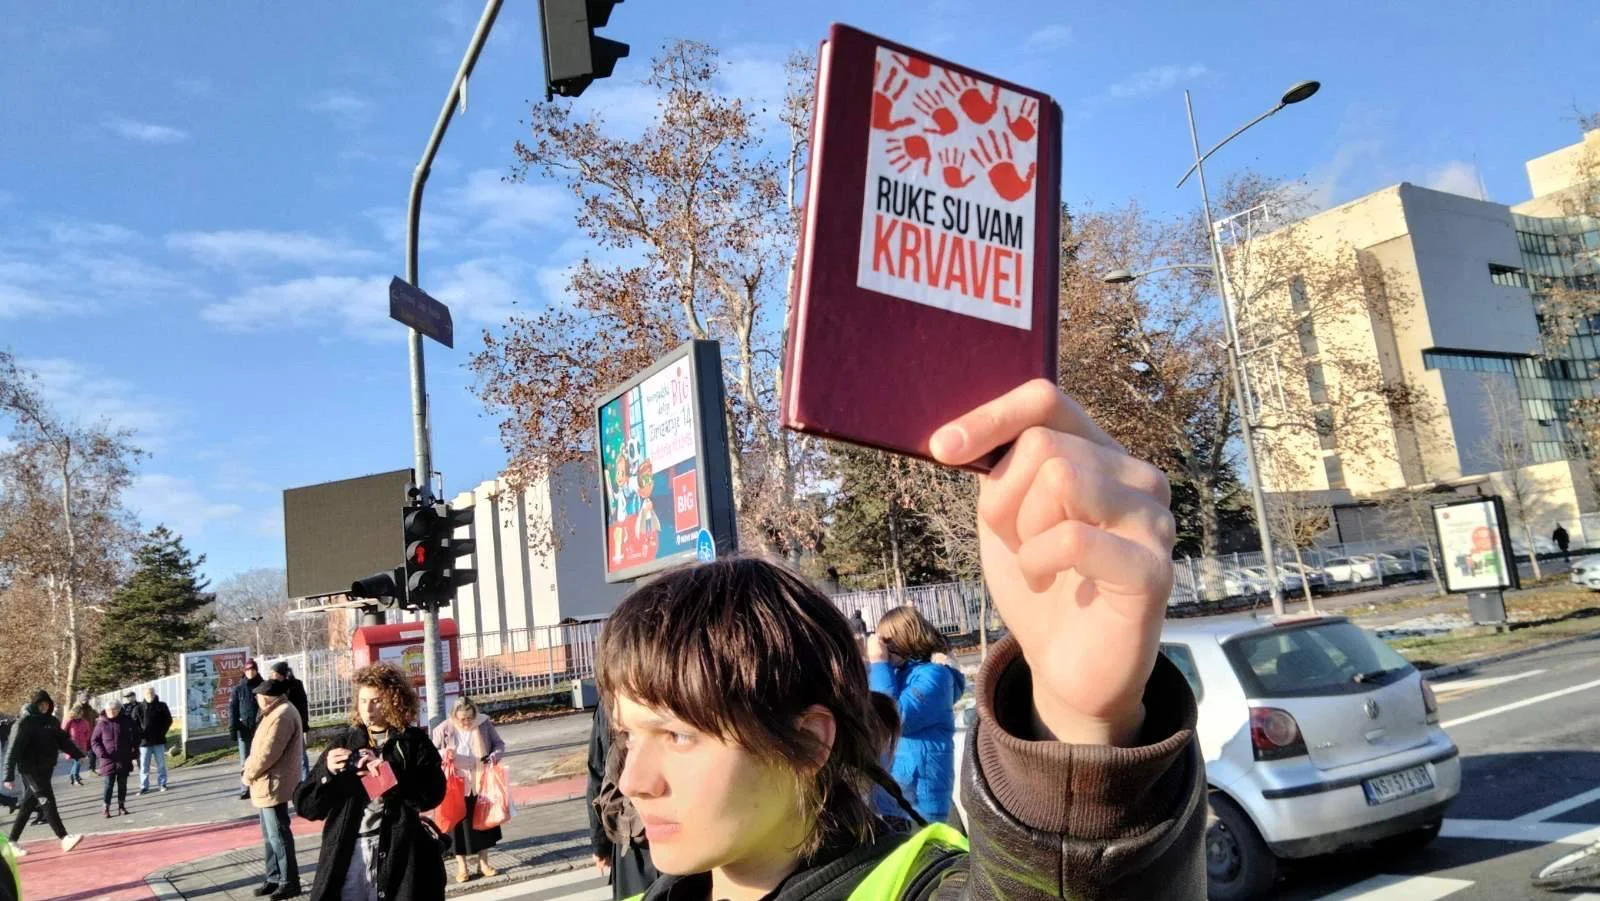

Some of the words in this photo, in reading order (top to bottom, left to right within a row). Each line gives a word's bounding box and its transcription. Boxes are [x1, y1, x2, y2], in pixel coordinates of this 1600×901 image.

[877, 176, 936, 226] RUKE
[942, 195, 970, 235] SU
[977, 204, 1023, 250] VAM
[872, 214, 1022, 308] KRVAVE!
[677, 490, 693, 512] BIG
[220, 659, 244, 669] VILA
